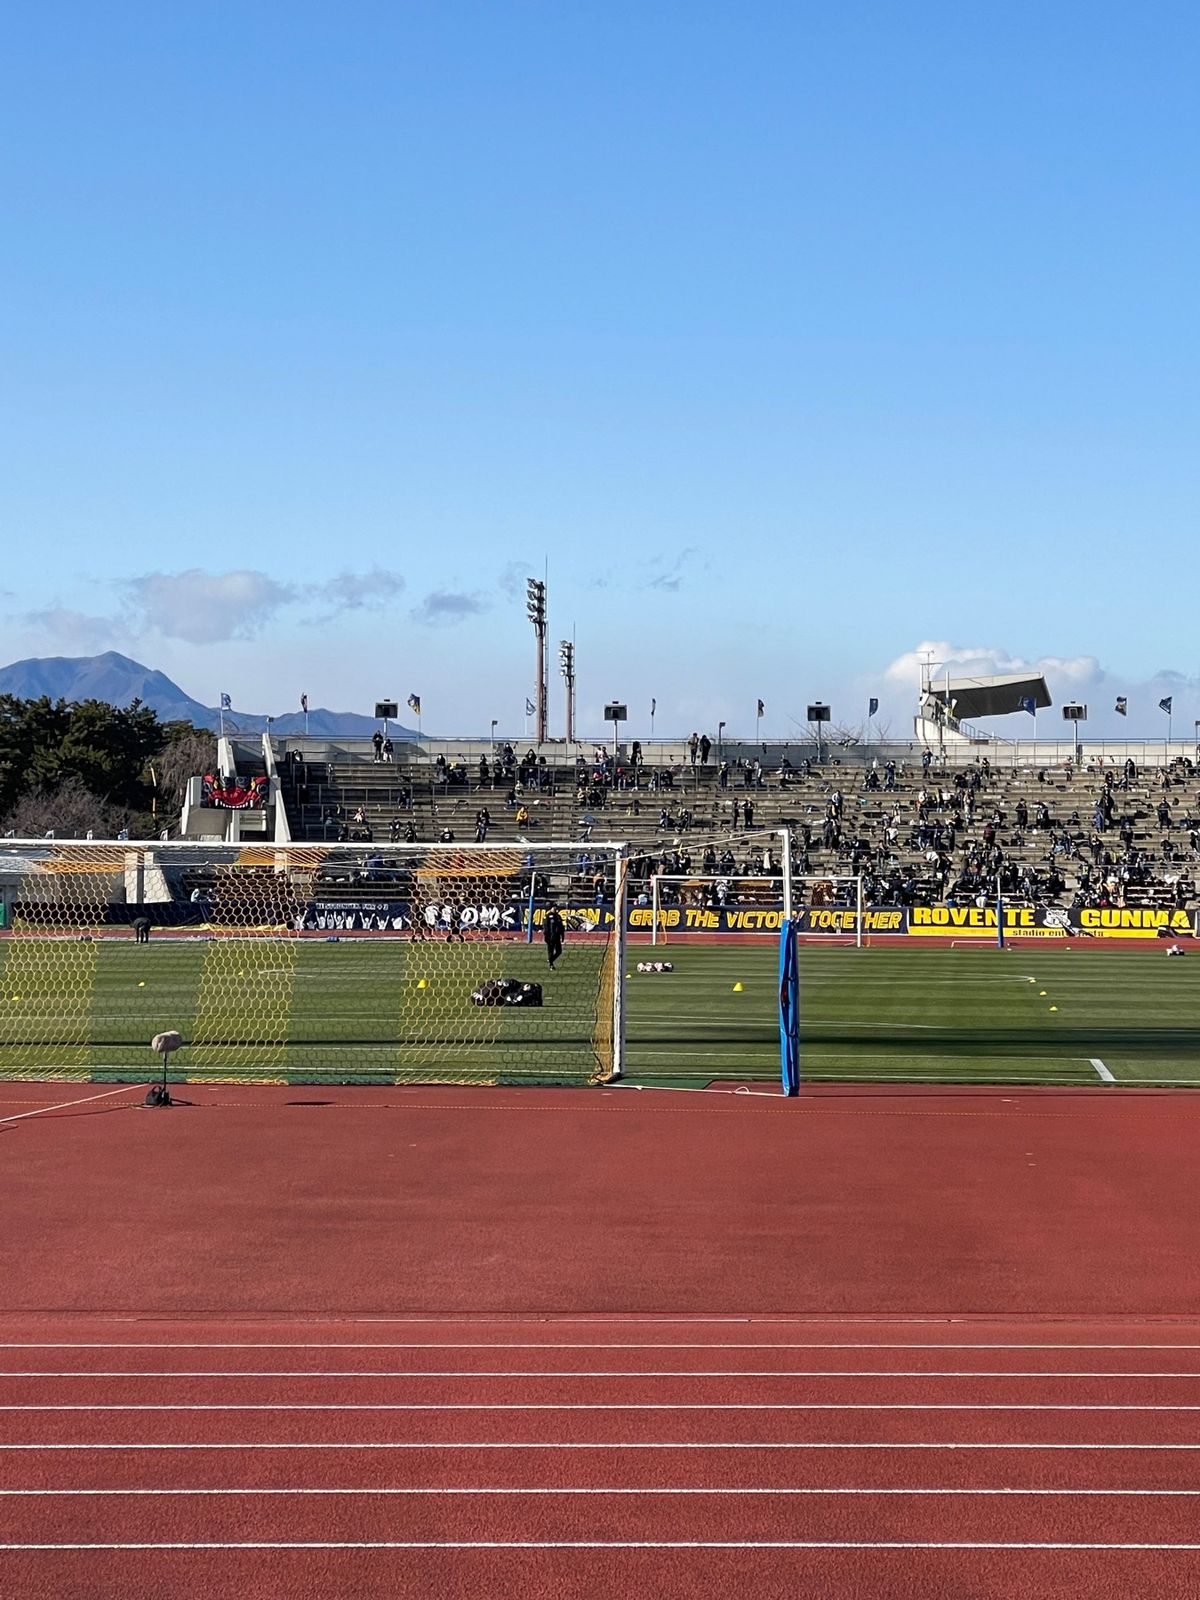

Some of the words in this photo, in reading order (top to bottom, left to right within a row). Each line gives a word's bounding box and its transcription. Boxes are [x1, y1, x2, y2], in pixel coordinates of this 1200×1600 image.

[523, 908, 600, 926] MISION
[629, 909, 680, 927] GRAB
[685, 909, 720, 928] THE
[913, 907, 1036, 927] ROVENTE
[1080, 909, 1190, 928] GUNMA
